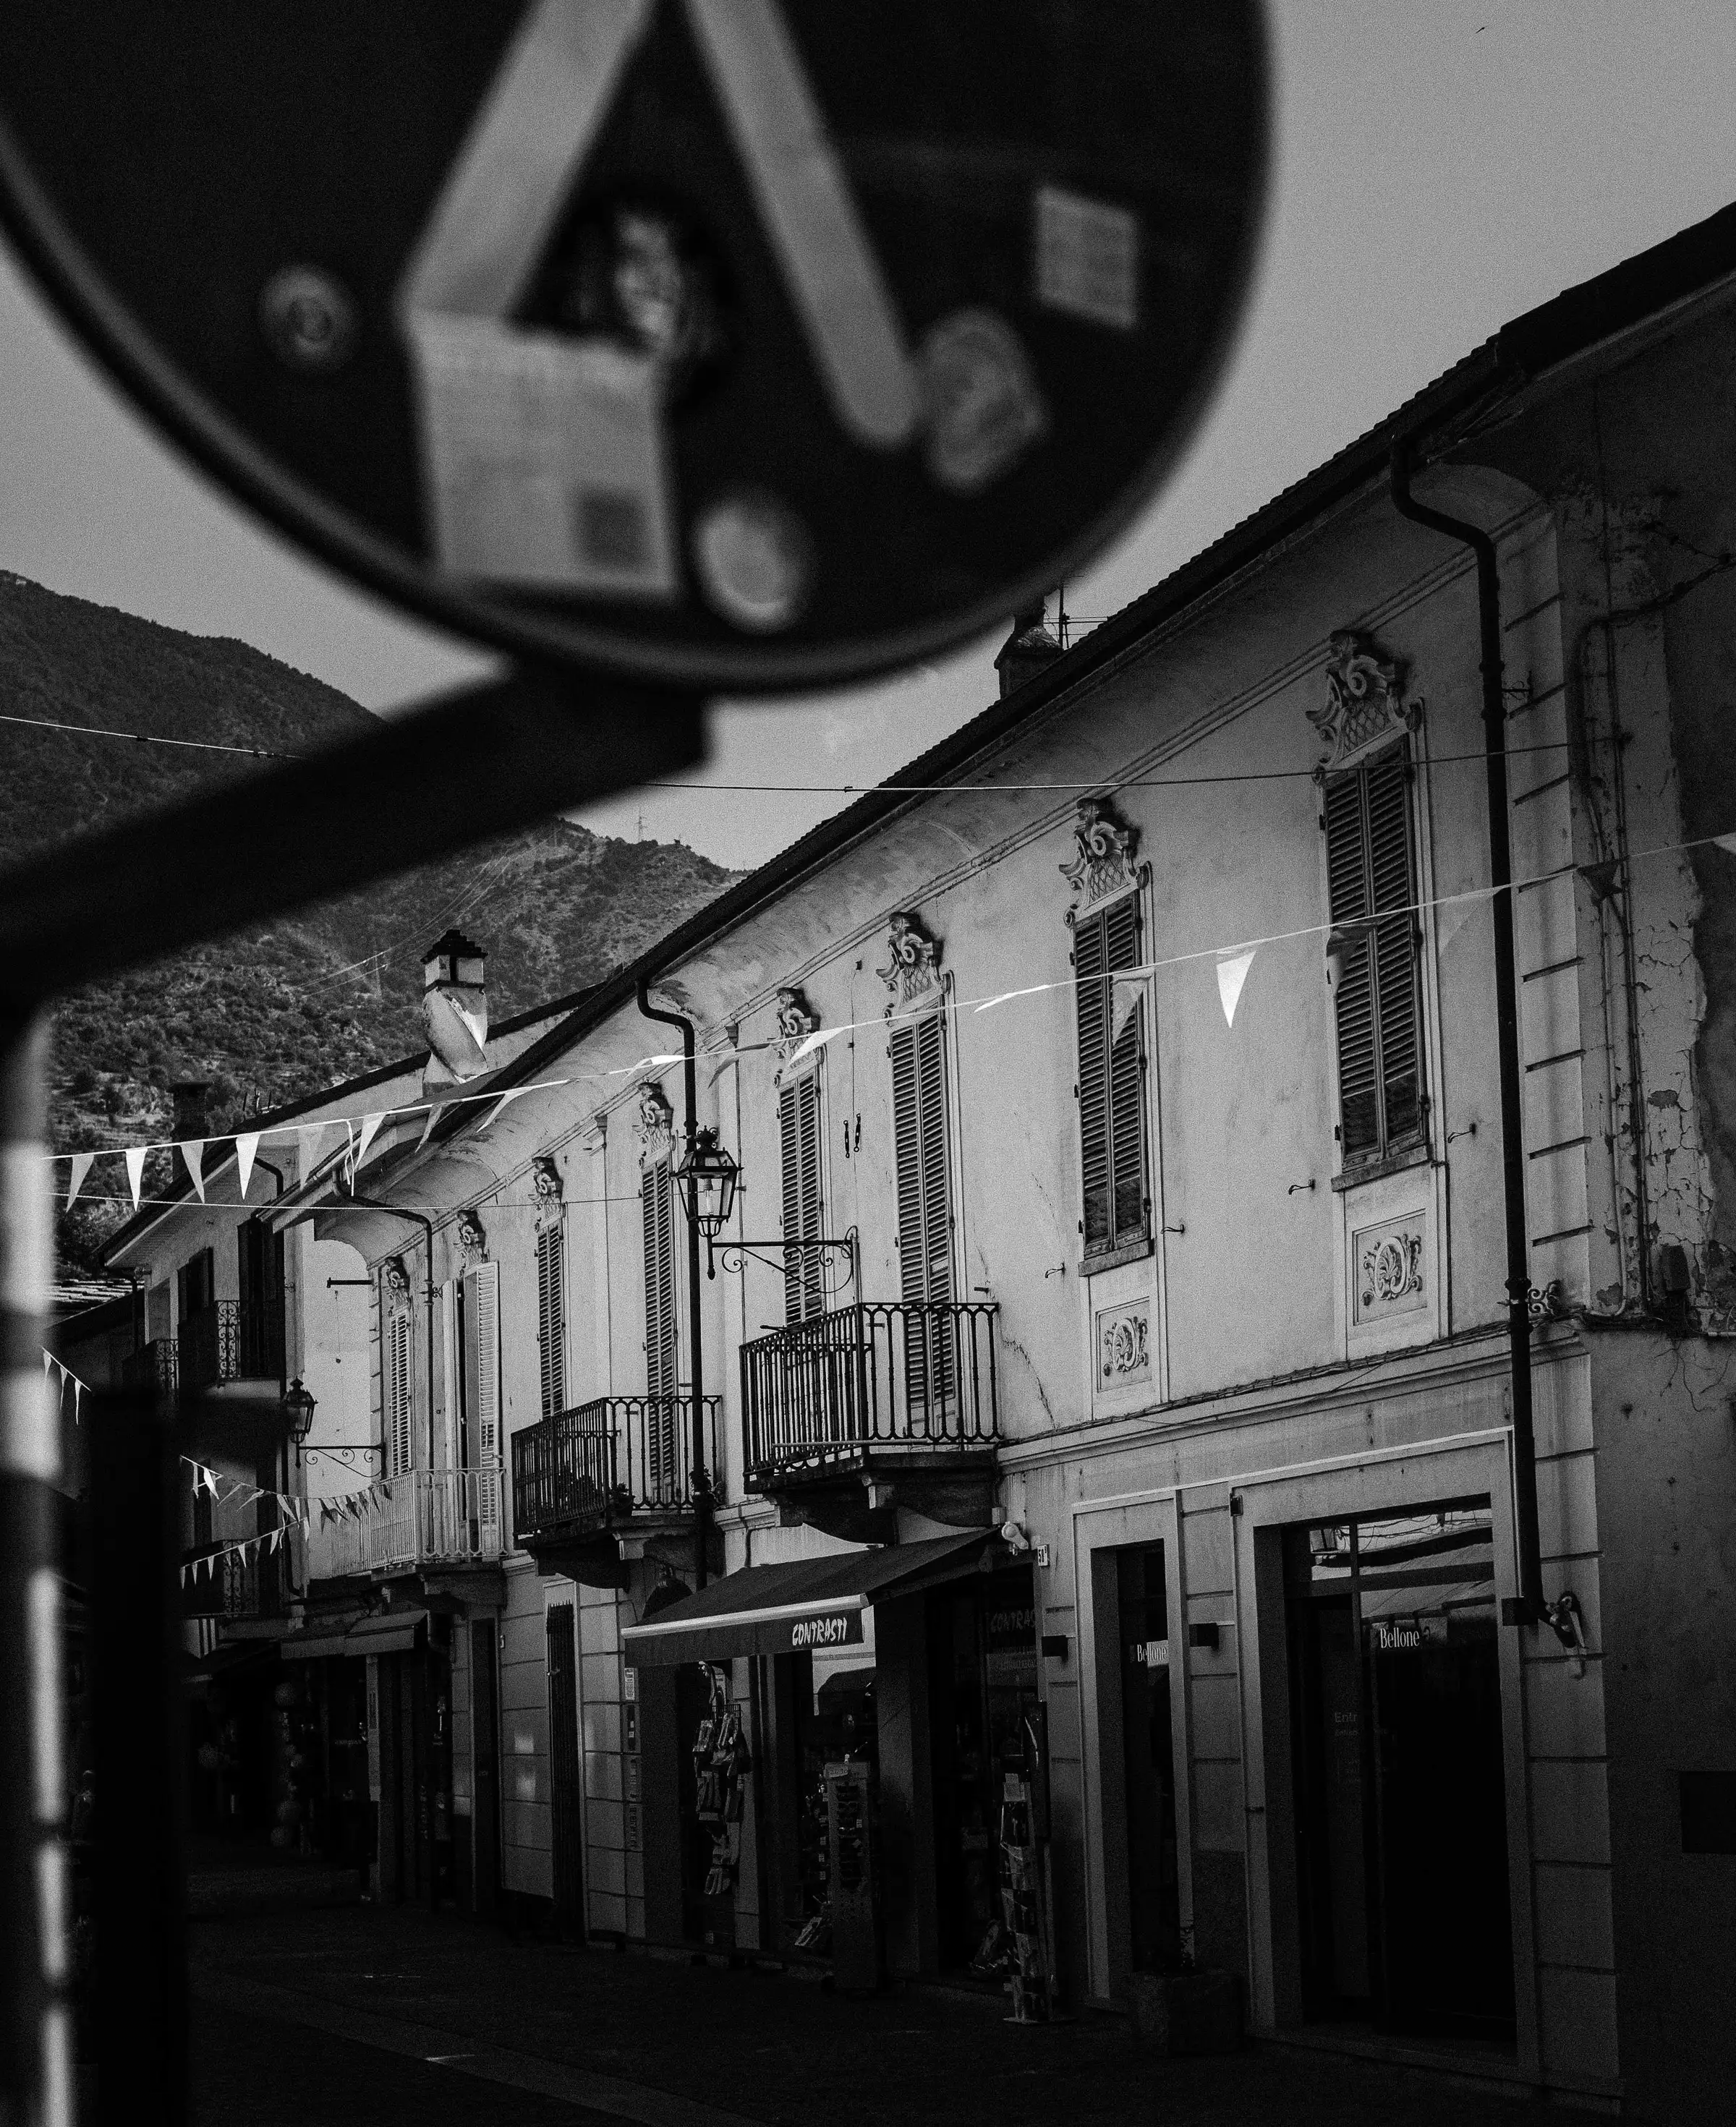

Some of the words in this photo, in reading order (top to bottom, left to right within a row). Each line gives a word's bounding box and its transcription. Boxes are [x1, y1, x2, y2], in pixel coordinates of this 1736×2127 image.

[792, 1617, 847, 1646] CONTRASTI
[1379, 1627, 1420, 1648] Bellone
[1136, 1643, 1167, 1663] Bellone
